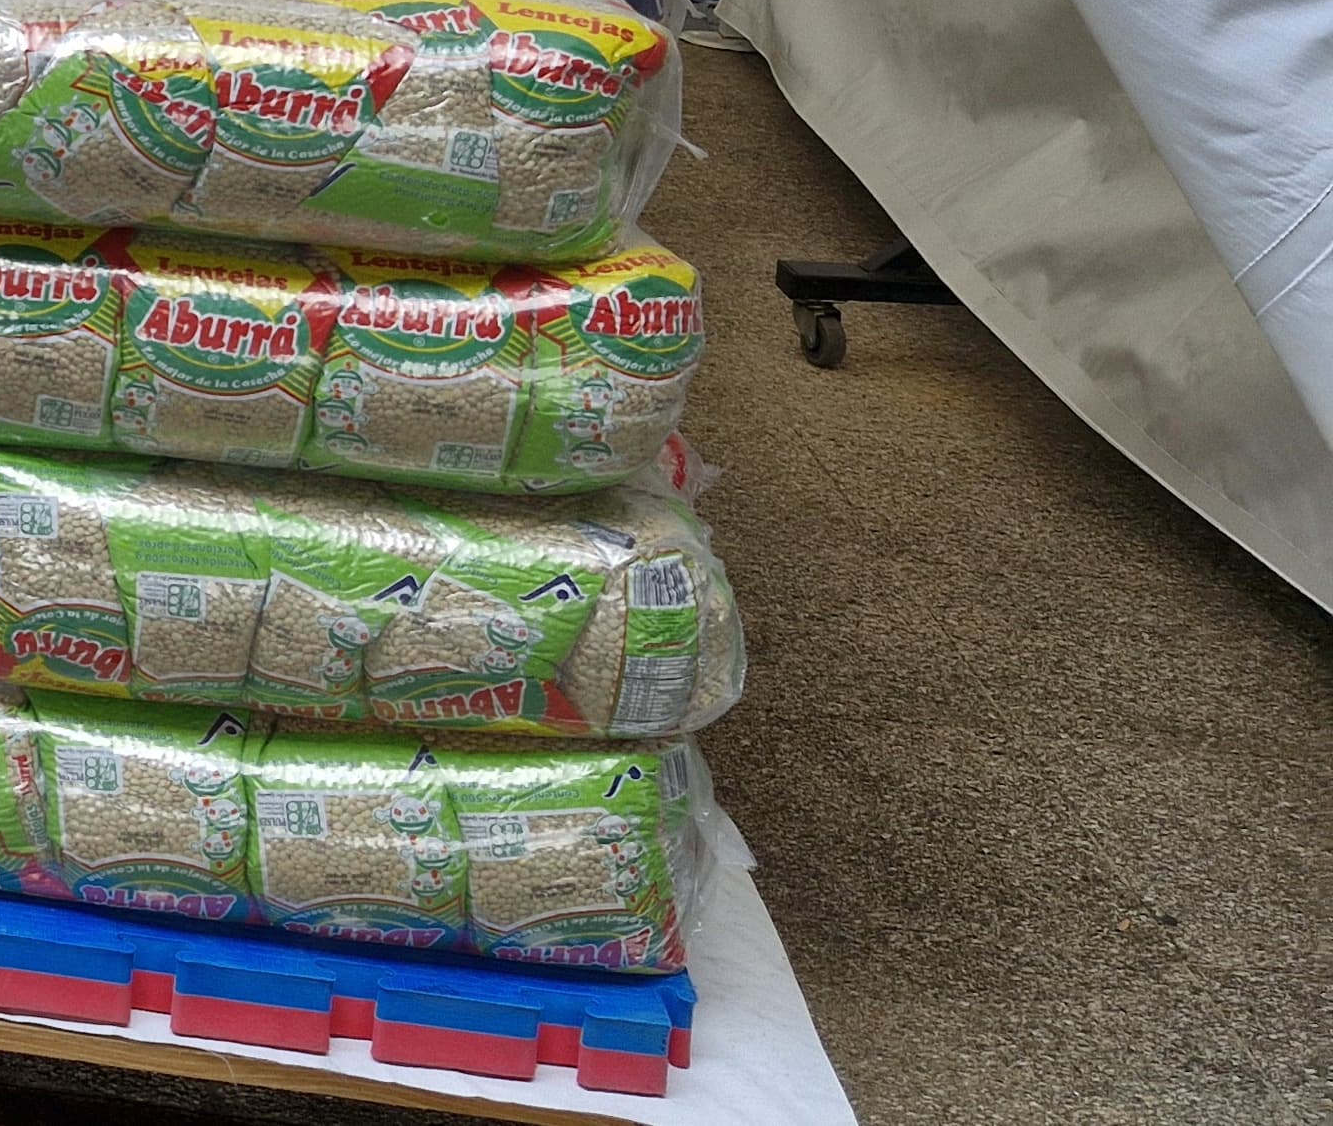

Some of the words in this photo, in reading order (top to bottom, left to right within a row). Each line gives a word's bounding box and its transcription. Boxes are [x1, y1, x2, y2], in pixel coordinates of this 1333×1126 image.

[498, 1, 635, 44] Lentejas
[288, 140, 345, 160] Cosecha
[157, 256, 289, 292] Lentejas
[350, 252, 486, 275] Lentejas
[135, 297, 301, 364] Aburrá
[338, 285, 505, 342] Aburrá
[139, 345, 157, 363] Lo
[157, 358, 192, 384] mejor
[194, 376, 212, 388] de
[231, 367, 287, 389] Cosecha
[343, 333, 360, 349] Lo
[361, 344, 401, 368] mejor
[175, 866, 211, 885] mejor
